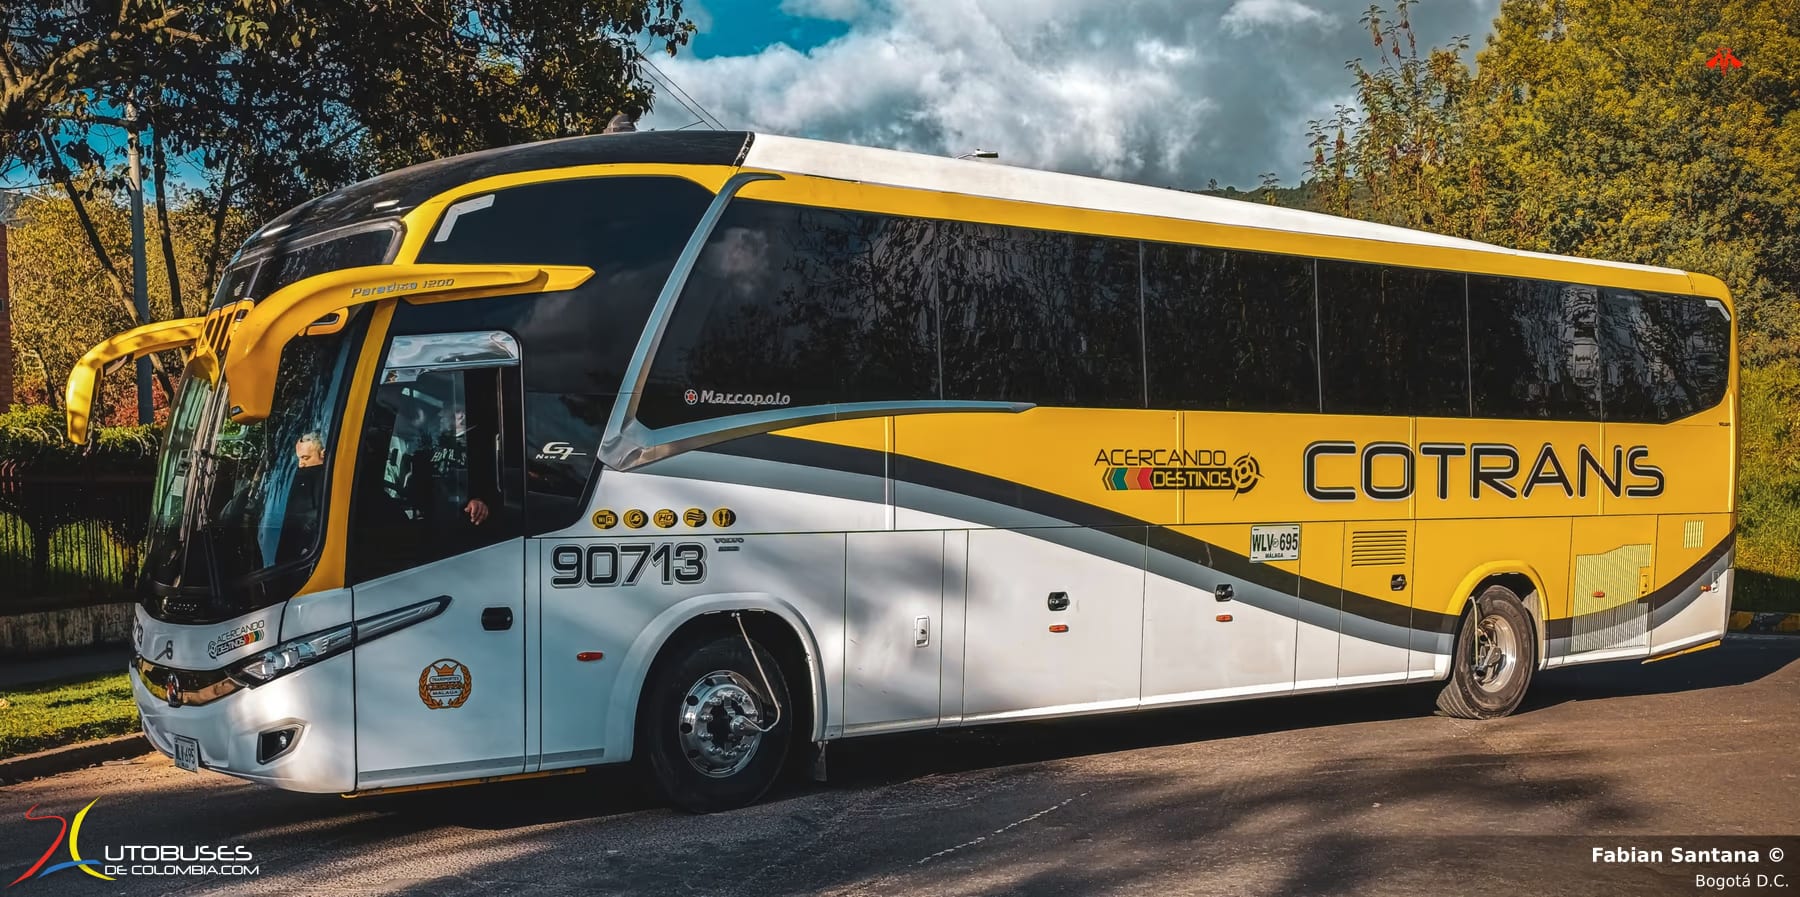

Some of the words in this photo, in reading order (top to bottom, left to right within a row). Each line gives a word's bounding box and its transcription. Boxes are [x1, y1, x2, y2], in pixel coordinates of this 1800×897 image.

[351, 282, 417, 298] Paradiso
[422, 278, 455, 289] 1200
[700, 390, 791, 406] Marcopolo
[1094, 449, 1226, 466] ACERCANDO
[1153, 471, 1231, 488] DESTINOS
[1303, 440, 1666, 502] COTRANS
[1252, 533, 1274, 552] WLV
[1279, 533, 1298, 551] 695
[551, 542, 708, 589] 90713
[217, 619, 265, 642] ACERCANDO
[217, 637, 245, 655] DESTINOS
